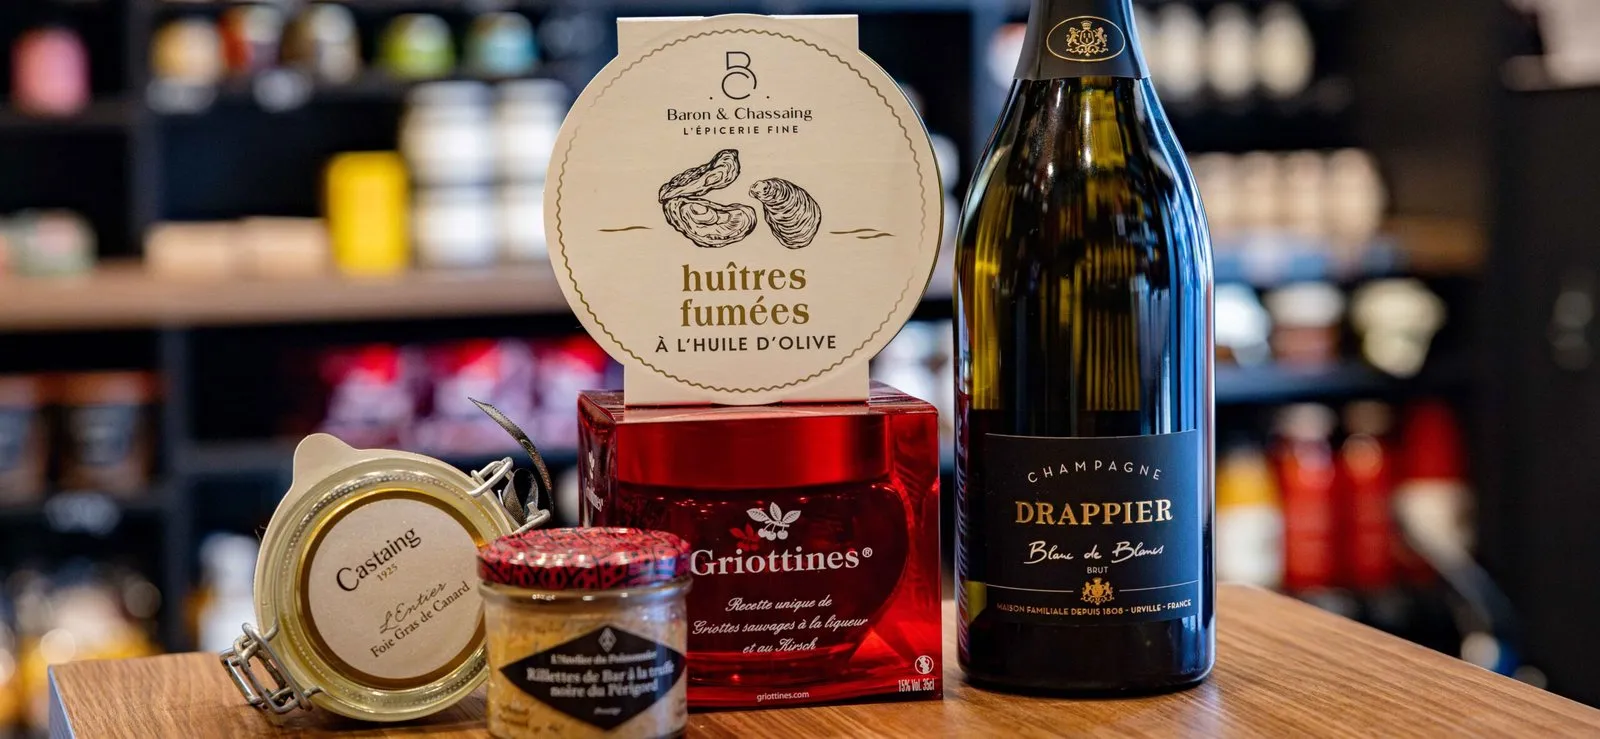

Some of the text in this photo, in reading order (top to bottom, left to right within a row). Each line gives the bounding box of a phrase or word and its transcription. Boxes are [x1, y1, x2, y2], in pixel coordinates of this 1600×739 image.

[667, 106, 813, 122] Baron & Chassaing
[683, 125, 799, 136] L'ÉPICERIE FINE
[681, 262, 807, 292] huîtres
[680, 295, 810, 327] fumées
[655, 335, 837, 353] À L'HUILE D'OLIVE
[1027, 459, 1162, 483] CHAMPAGNE
[1015, 499, 1174, 526] DRAPPIER
[336, 527, 422, 592] Castaing
[1023, 540, 1165, 565] Blanc de Blancs
[376, 563, 398, 582] 1925
[1086, 566, 1109, 574] BRUT
[725, 594, 833, 613] Recette unique de
[996, 602, 1025, 613] MAISON
[1026, 606, 1069, 615] FAMILIALE
[1070, 607, 1101, 616] DEPUIS
[1102, 607, 1124, 616] 1808
[1130, 603, 1161, 614] URVILLE
[1167, 599, 1192, 610] FRANCE
[370, 580, 471, 658] Foie Gras de Canard
[692, 614, 869, 635] Griottes sauvages à la liqueur
[742, 637, 819, 654] et au Kirsch
[526, 667, 581, 684] Rillettes
[582, 669, 600, 684] de
[601, 668, 626, 683] Bar
[898, 679, 911, 692] 15%
[922, 677, 935, 691] 35cl
[586, 683, 606, 698] du
[756, 691, 810, 703] griottines.com
